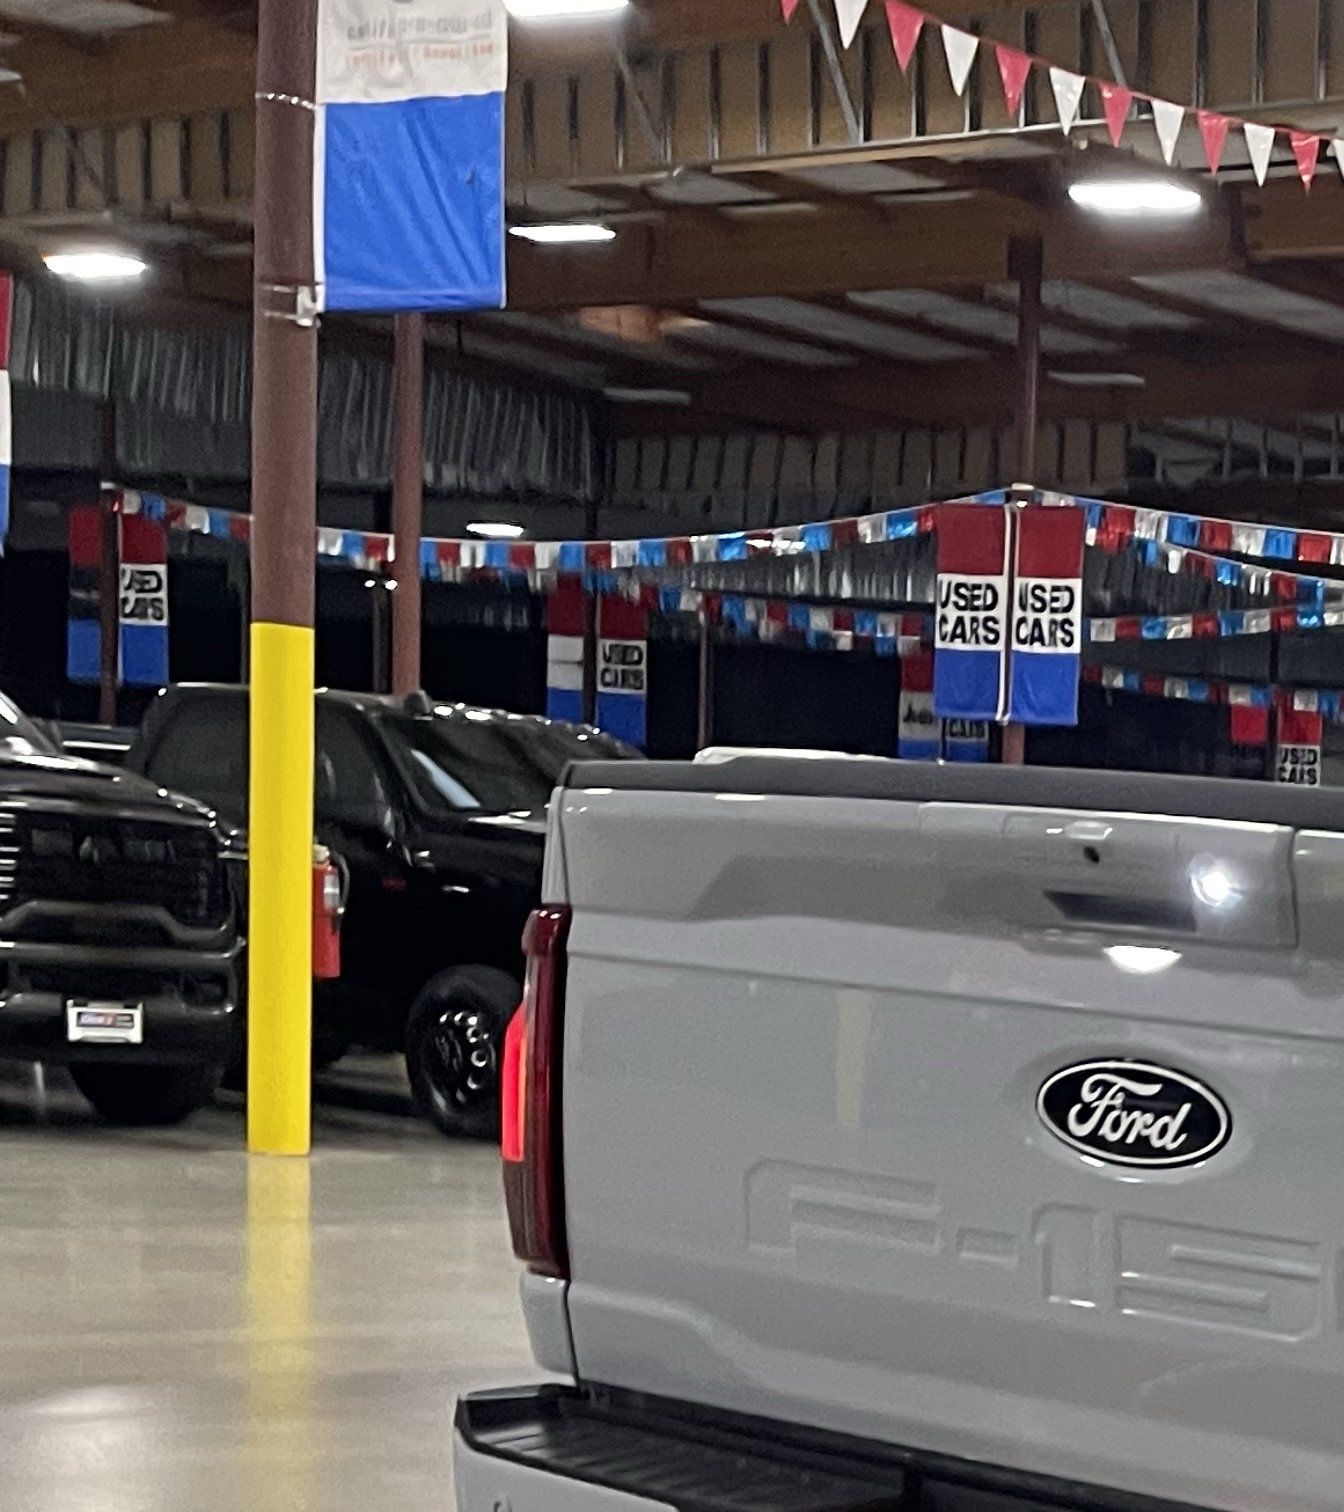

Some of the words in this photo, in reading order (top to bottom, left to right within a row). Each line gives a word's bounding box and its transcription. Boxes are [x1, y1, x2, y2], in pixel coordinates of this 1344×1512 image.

[939, 580, 999, 612] USED
[1018, 582, 1075, 613] USED
[938, 614, 1000, 645] CARS
[1015, 616, 1075, 647] CARS
[1067, 1072, 1193, 1151] Ford
